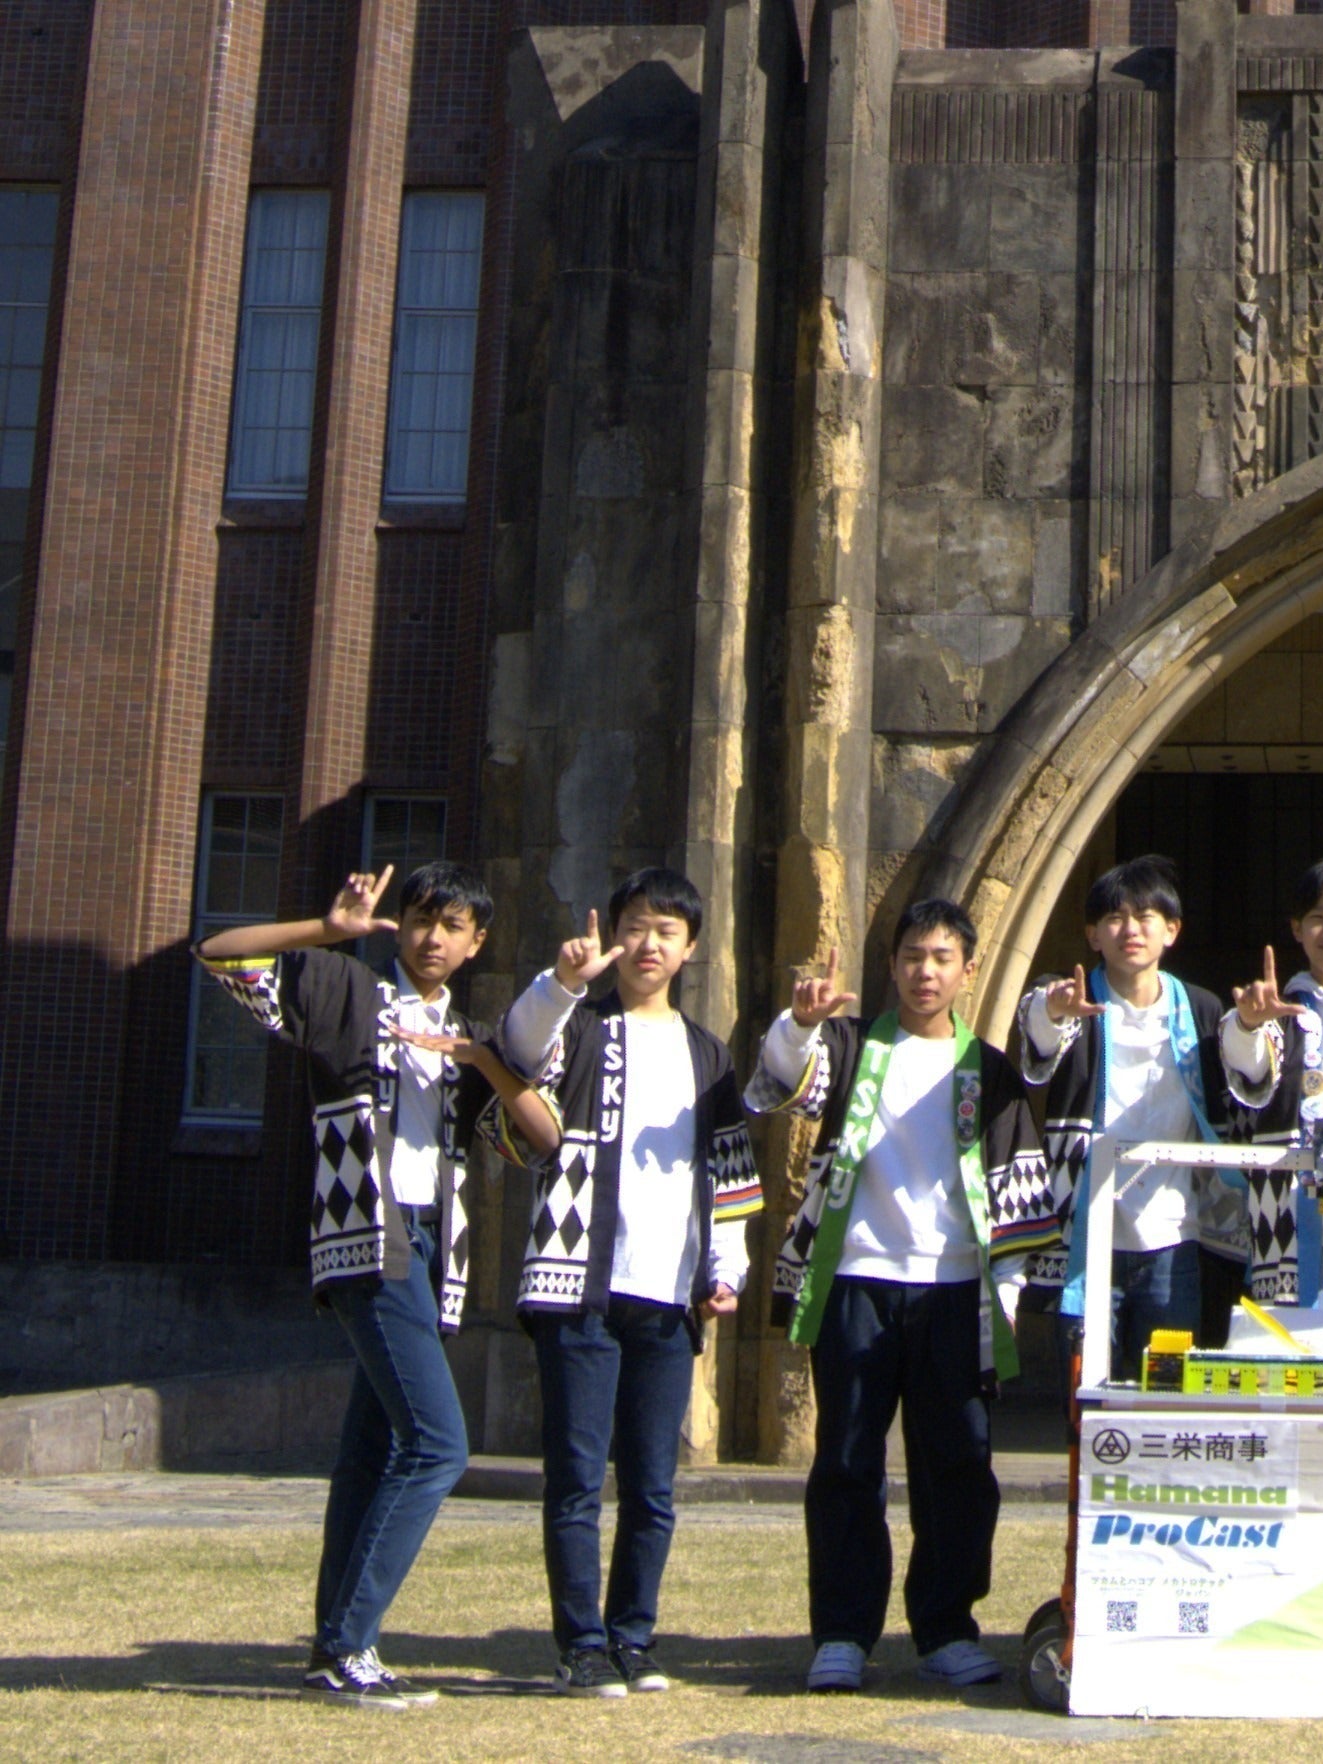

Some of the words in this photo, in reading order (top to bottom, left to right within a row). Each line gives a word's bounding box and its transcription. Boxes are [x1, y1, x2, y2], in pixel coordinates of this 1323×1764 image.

[1138, 1432, 1269, 1462] 三栄商事
[1091, 1474, 1288, 1505] Hamana
[1091, 1515, 1286, 1549] ProCast
